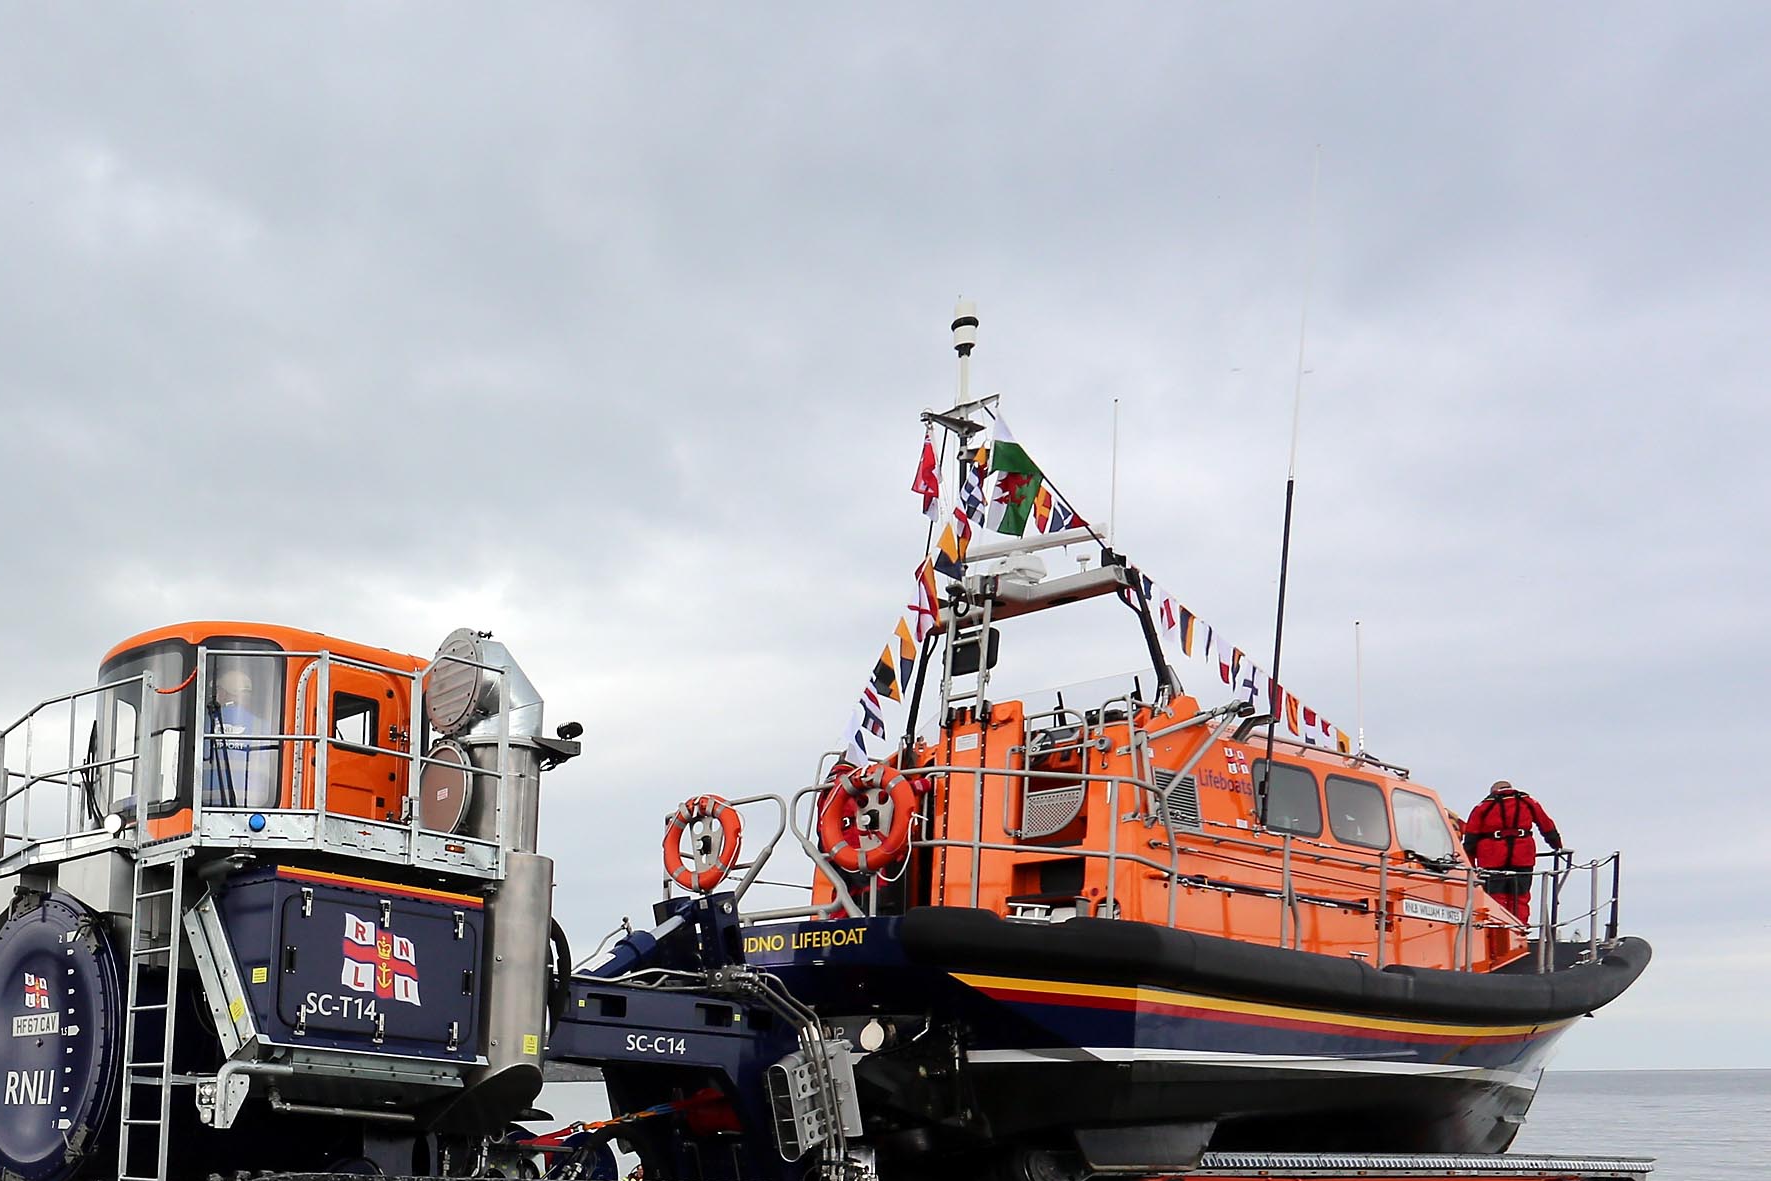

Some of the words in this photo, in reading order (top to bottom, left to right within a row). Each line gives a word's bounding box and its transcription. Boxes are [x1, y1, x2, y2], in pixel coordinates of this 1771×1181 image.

[1198, 767, 1253, 796] Lifeboats
[58, 934, 63, 944] 2
[355, 921, 367, 942] R
[399, 940, 409, 958] N
[791, 927, 867, 950] LIFEBOAT
[353, 966, 365, 988] L
[404, 980, 409, 998] I
[306, 992, 377, 1021] SC-T14
[16, 1017, 39, 1034] HF67
[40, 1015, 57, 1032] CAV
[625, 1034, 687, 1055] SC-C14
[4, 1069, 55, 1105] RNLI
